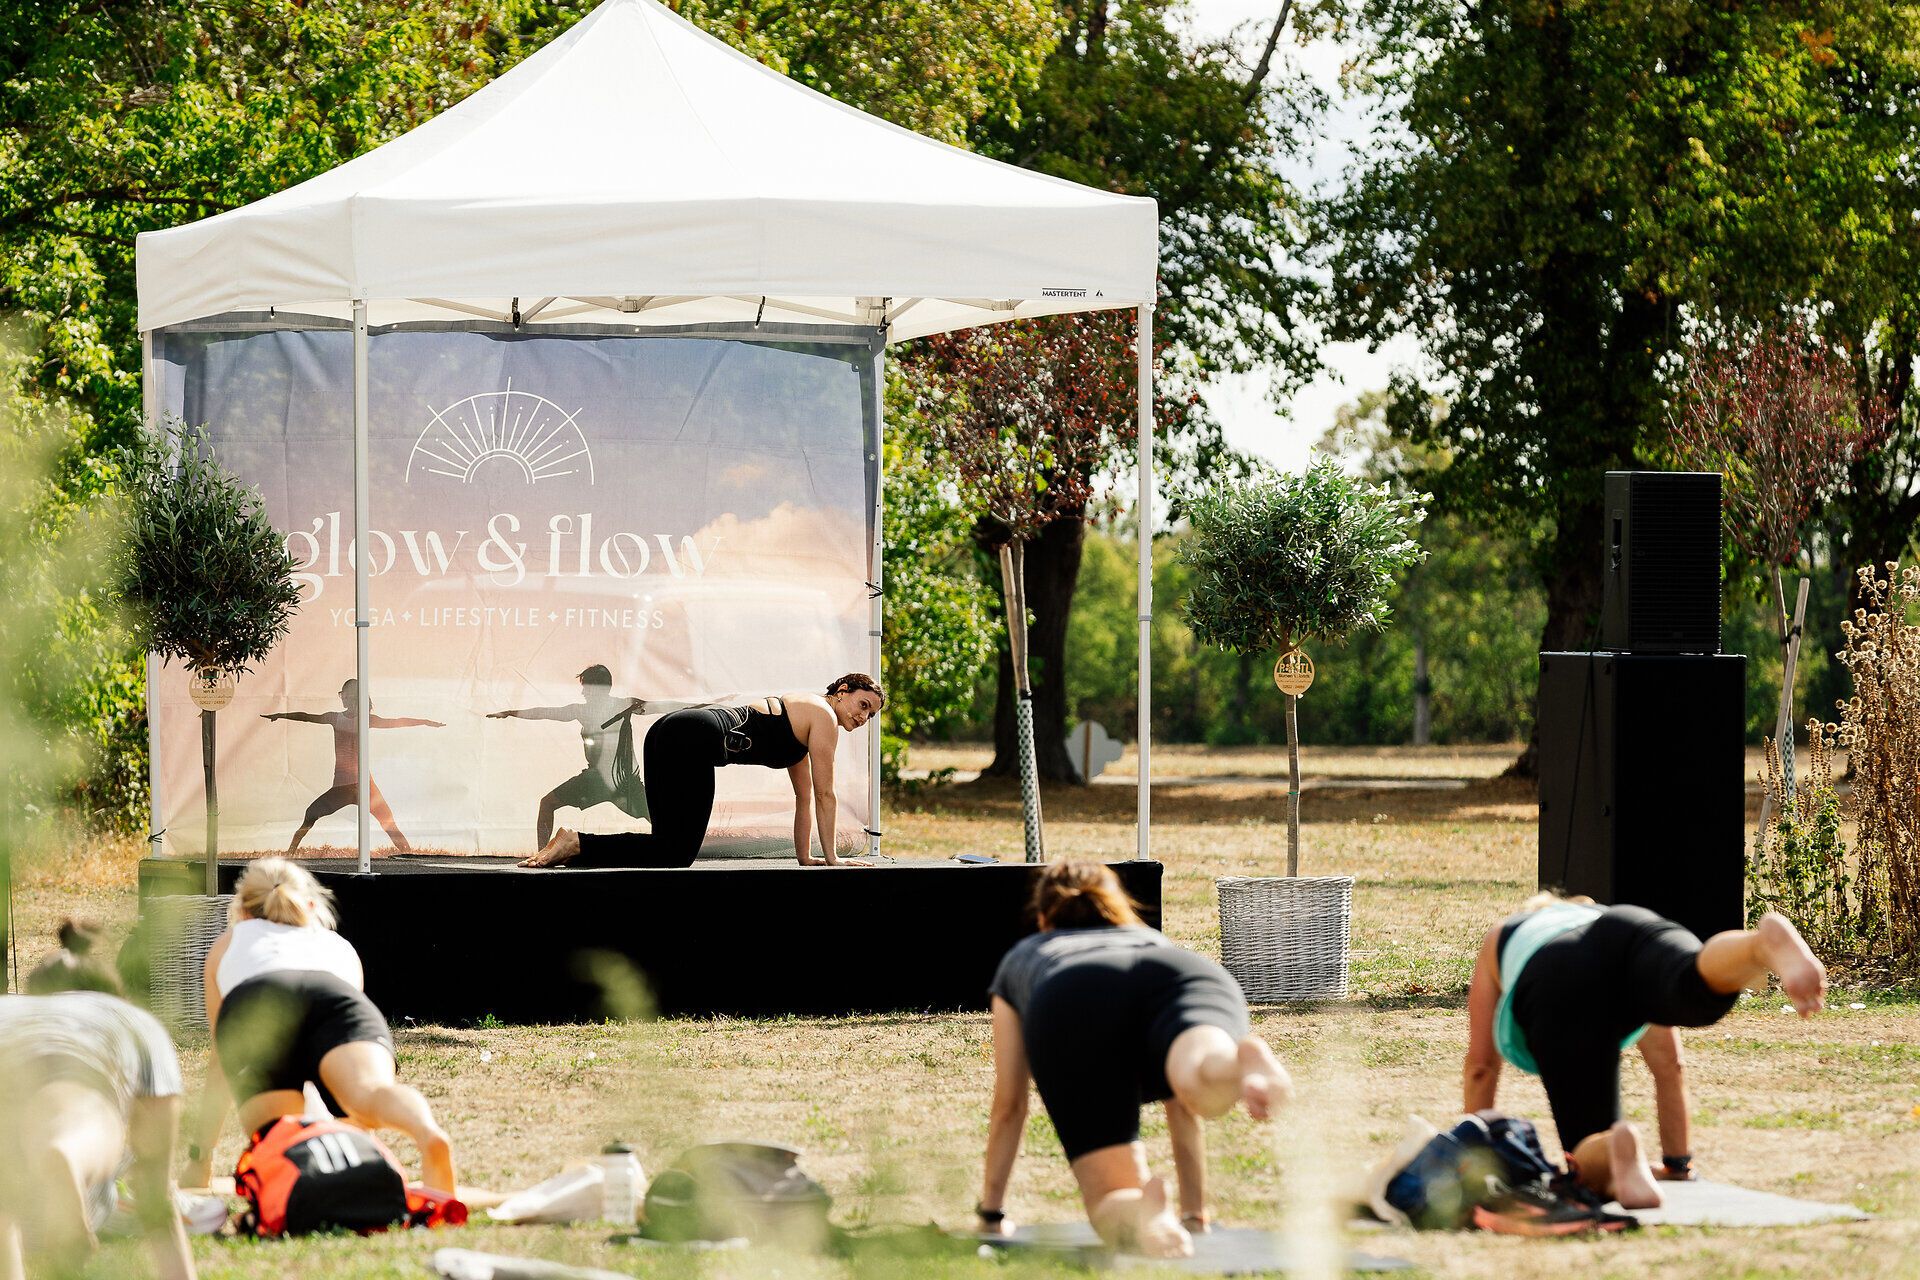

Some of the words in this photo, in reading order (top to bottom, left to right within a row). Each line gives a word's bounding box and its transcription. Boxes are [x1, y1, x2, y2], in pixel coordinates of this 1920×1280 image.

[1041, 290, 1087, 298] MASTERTENT
[280, 511, 470, 604] glow
[477, 513, 527, 587] &
[544, 512, 727, 580] flow
[420, 607, 540, 626] LIFESTYLE
[565, 608, 664, 629] FITNESS
